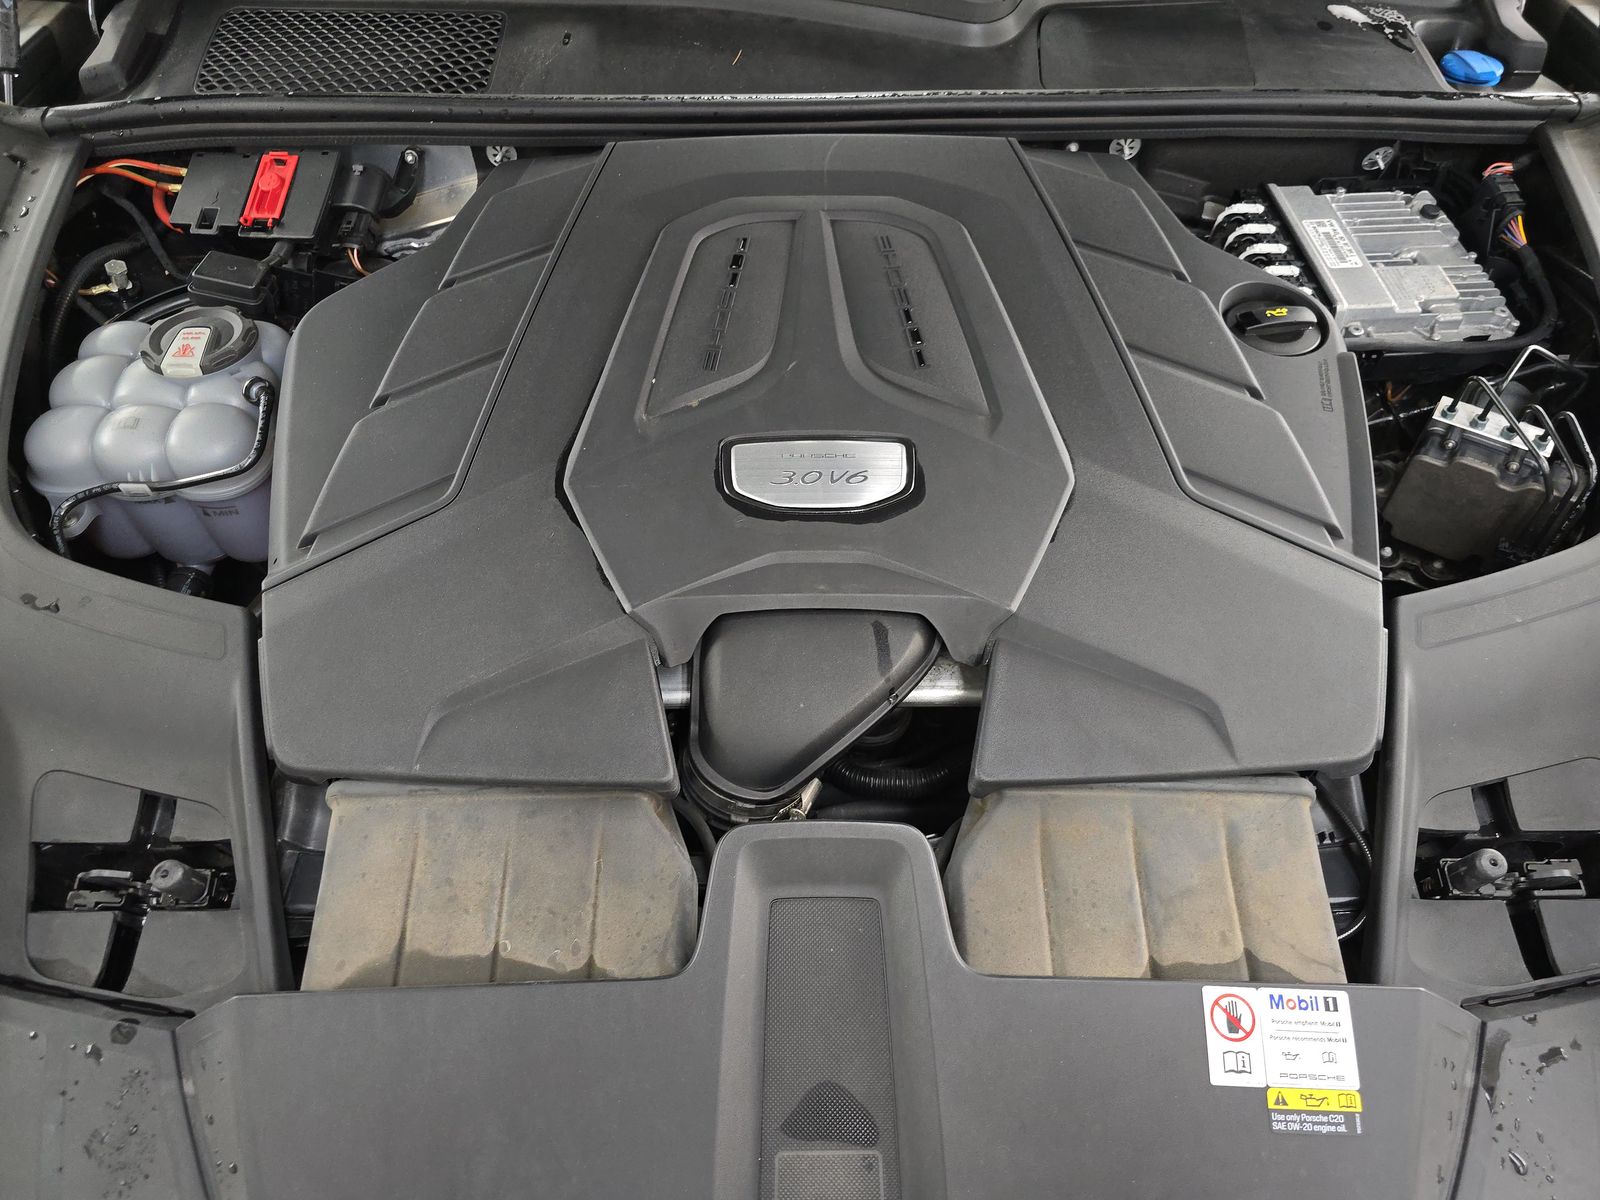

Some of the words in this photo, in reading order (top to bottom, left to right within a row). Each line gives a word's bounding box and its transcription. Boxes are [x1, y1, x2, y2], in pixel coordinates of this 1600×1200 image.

[702, 237, 749, 372] PORSCHE
[770, 470, 823, 486] 3.0
[829, 469, 870, 485] V6
[1269, 994, 1319, 1011] Mobil
[1323, 996, 1339, 1012] 1
[1280, 1072, 1345, 1081] PORSCHE
[1271, 1112, 1285, 1121] Use
[1286, 1114, 1300, 1123] only
[1301, 1114, 1328, 1122] Porsche
[1329, 1114, 1344, 1123] C20
[1272, 1122, 1287, 1130] SAE
[1313, 1124, 1336, 1134] engine
